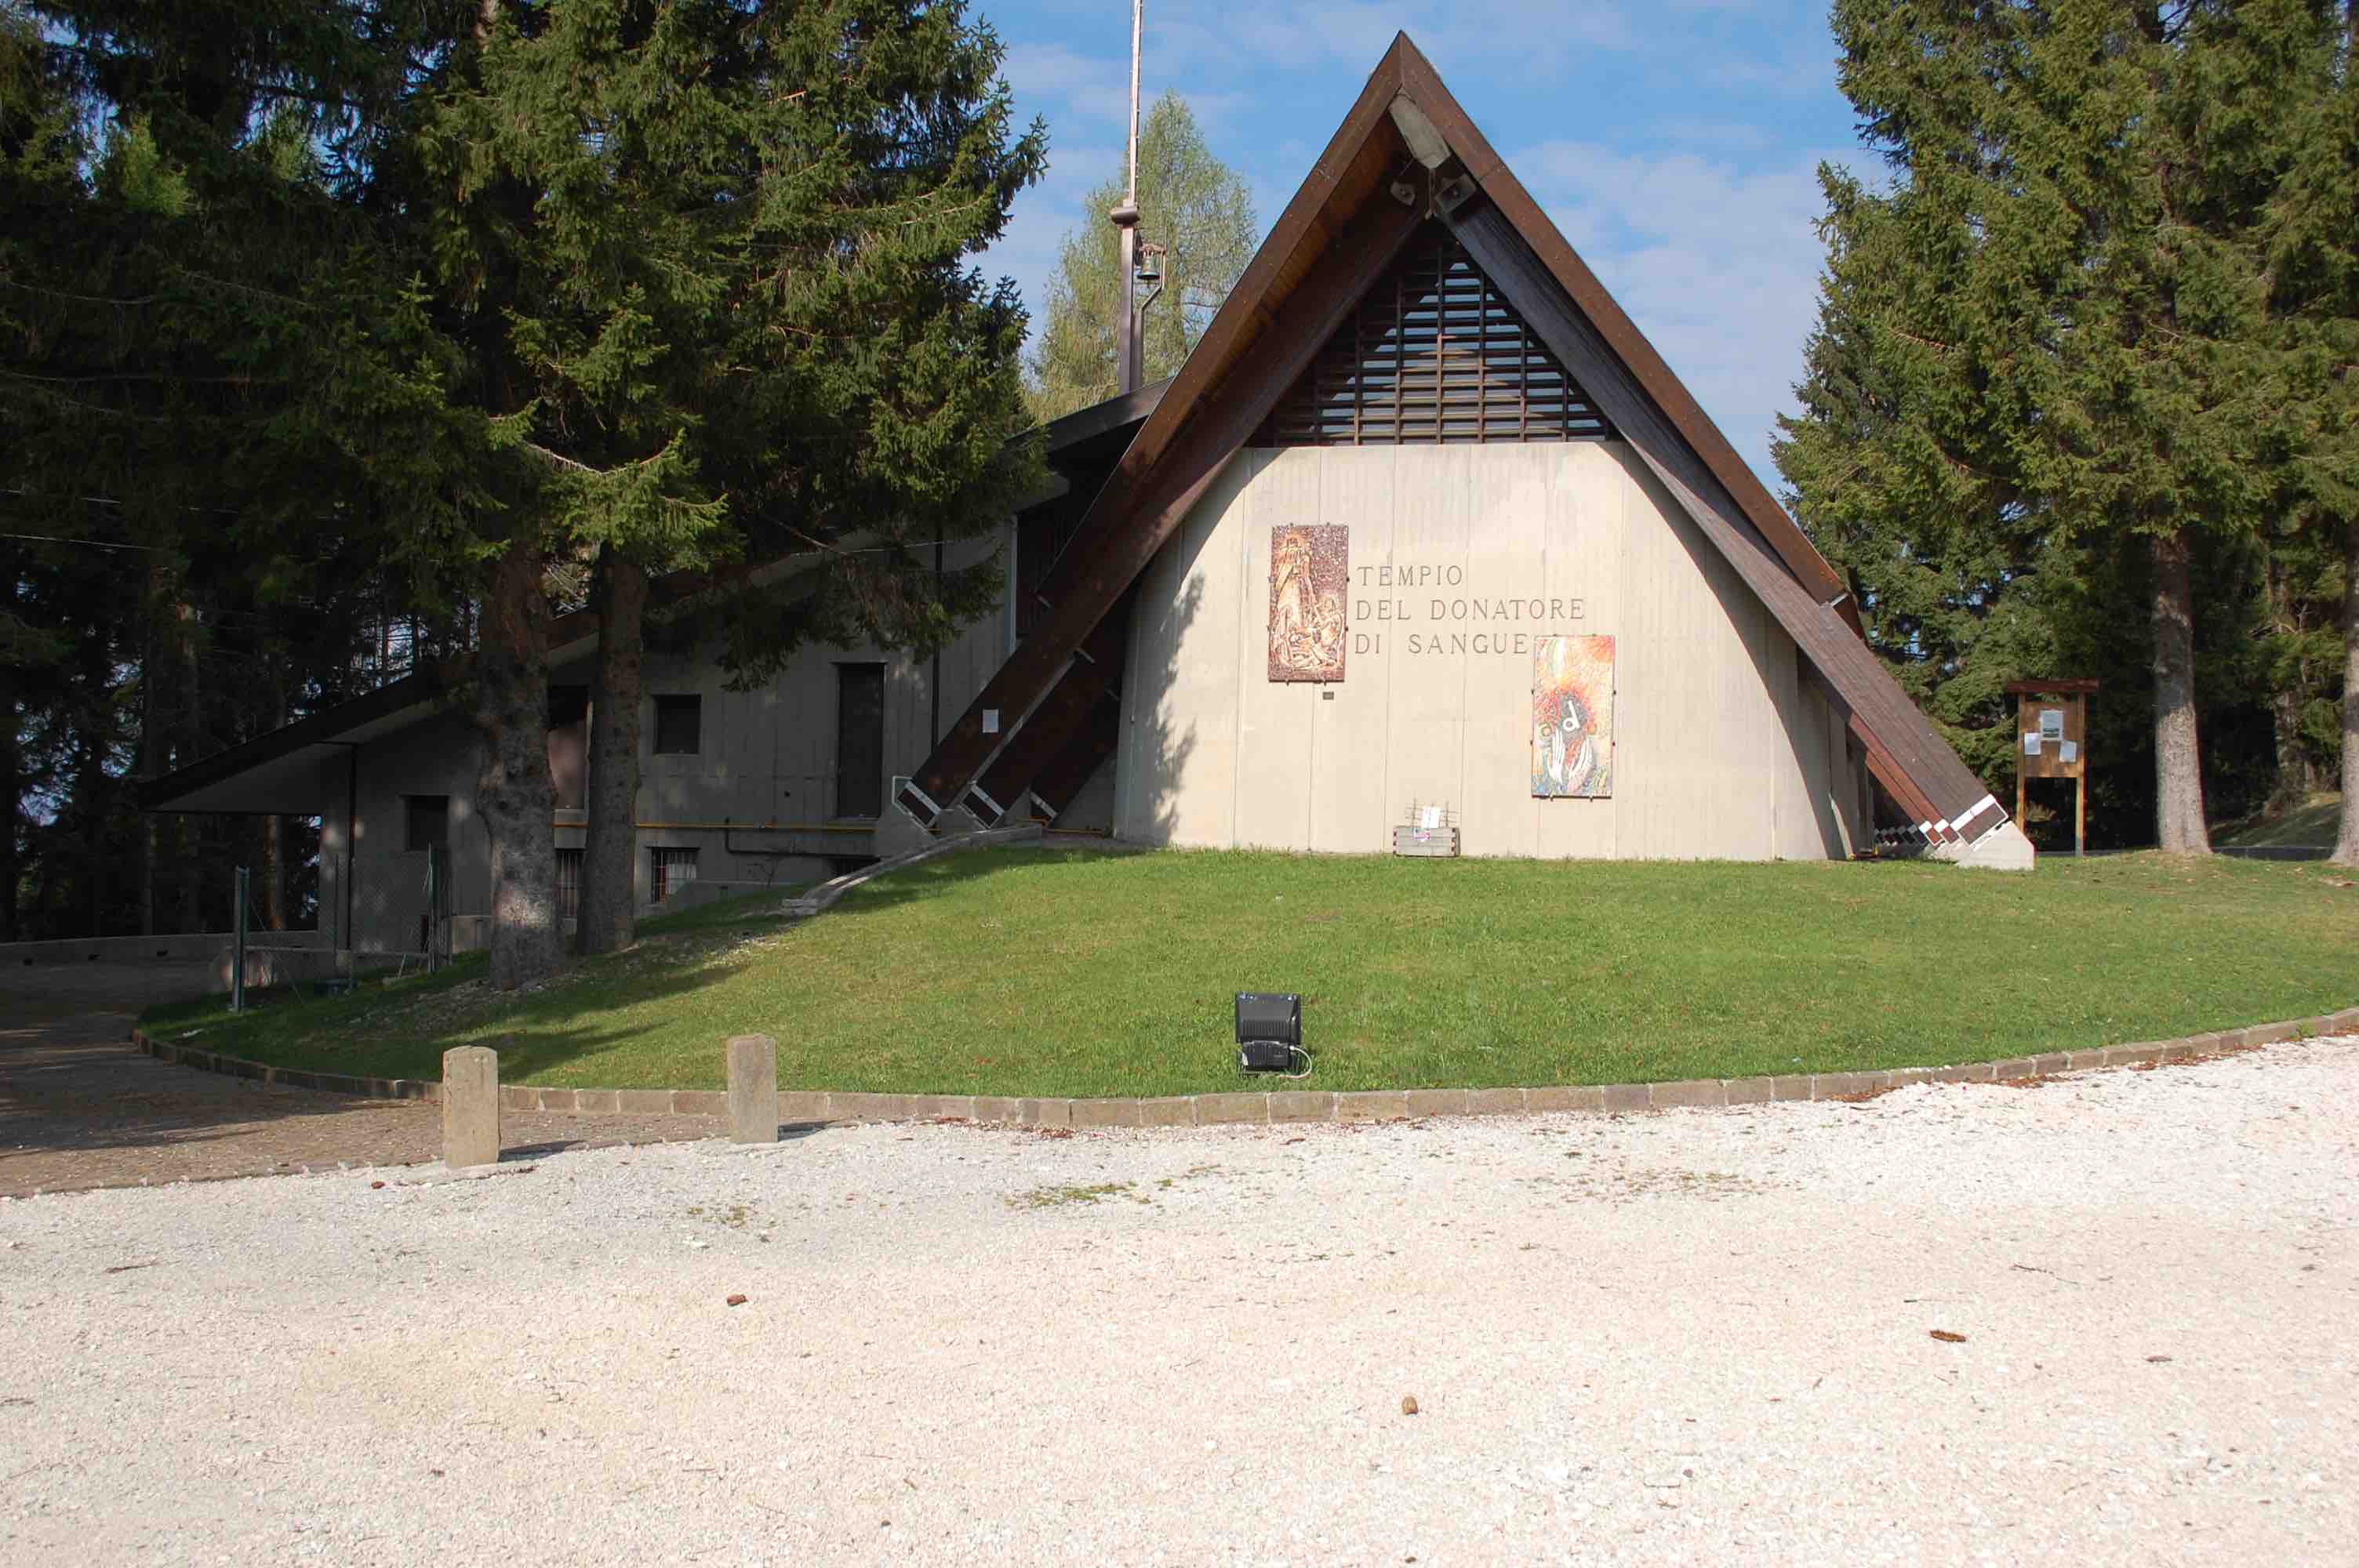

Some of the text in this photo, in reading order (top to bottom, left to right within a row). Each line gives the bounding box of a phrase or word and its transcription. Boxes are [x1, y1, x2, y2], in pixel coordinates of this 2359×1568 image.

[1358, 565, 1463, 586] TEMPIO
[1355, 599, 1585, 620] DEL DONATORE
[1354, 633, 1527, 655] DI SANGUE
